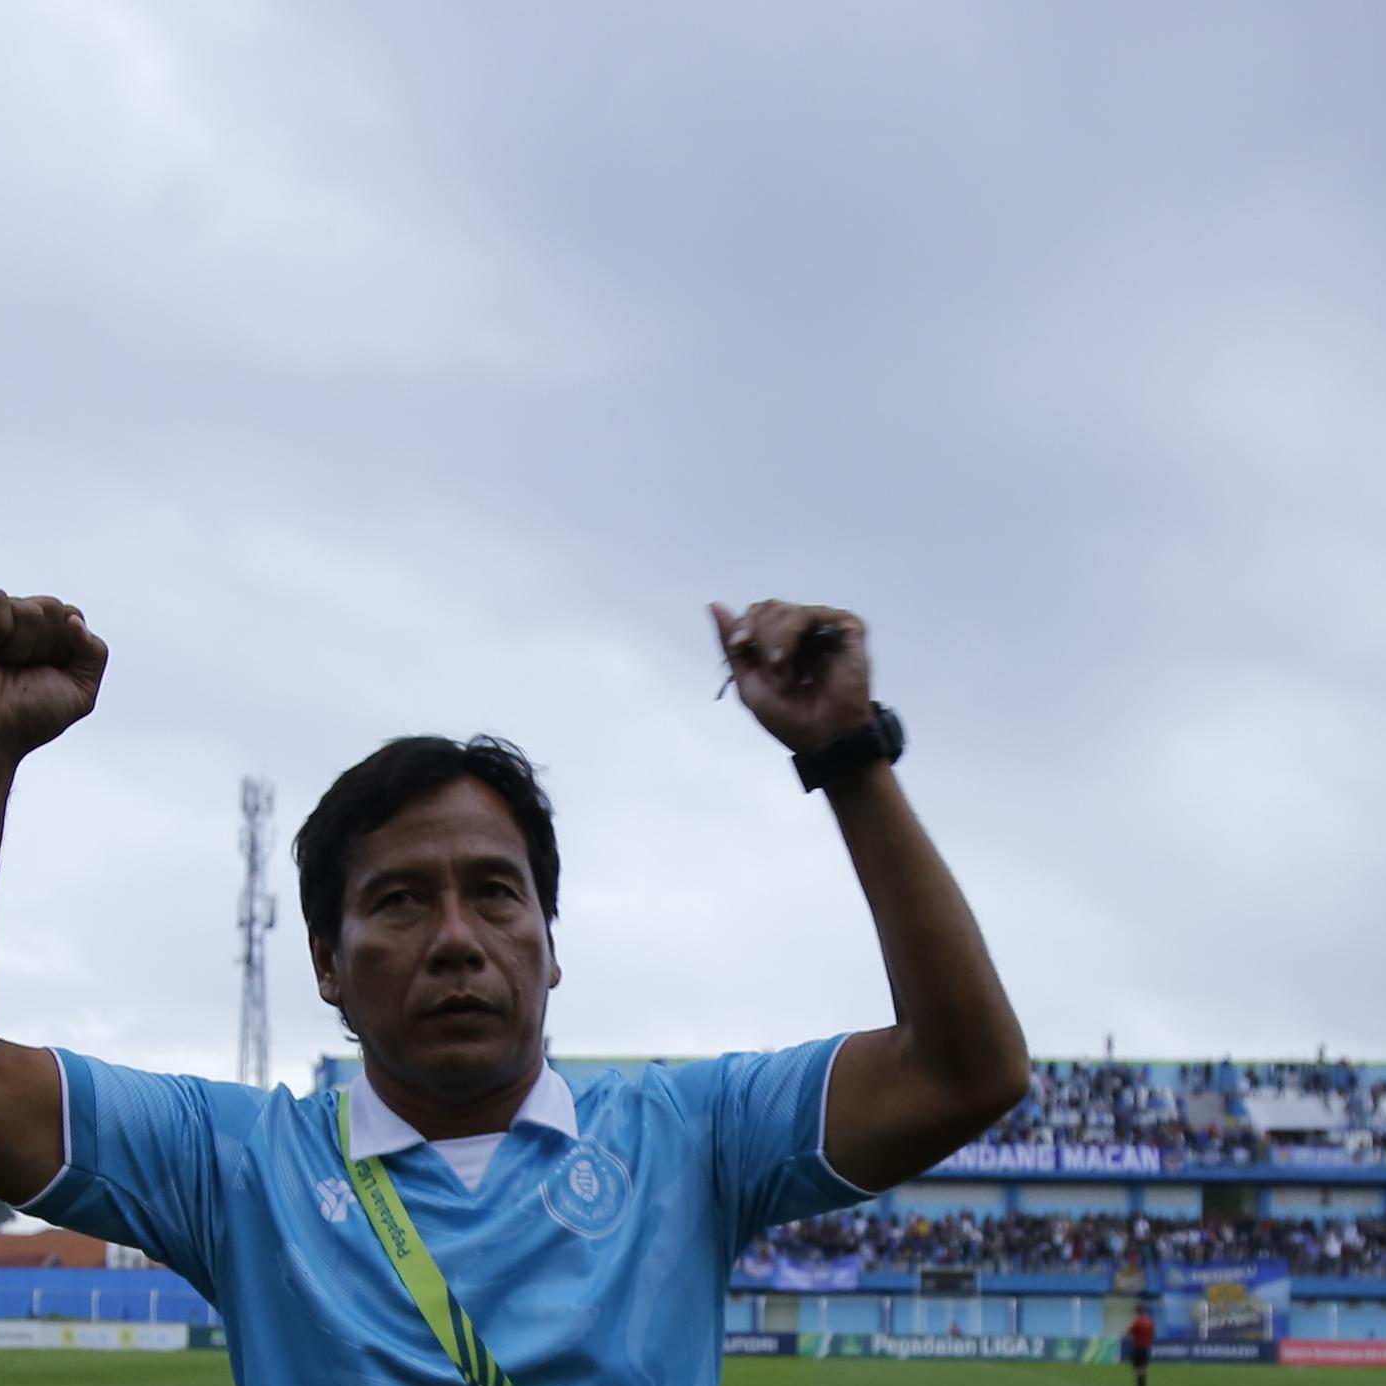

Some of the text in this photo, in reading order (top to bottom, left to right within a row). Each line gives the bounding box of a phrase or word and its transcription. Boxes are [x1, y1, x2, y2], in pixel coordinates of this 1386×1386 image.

[938, 1143, 1162, 1174] ANDANG MACAN
[371, 1190, 410, 1258] Pegadaian
[871, 1336, 1045, 1358] Pegadaian LIGA 2
